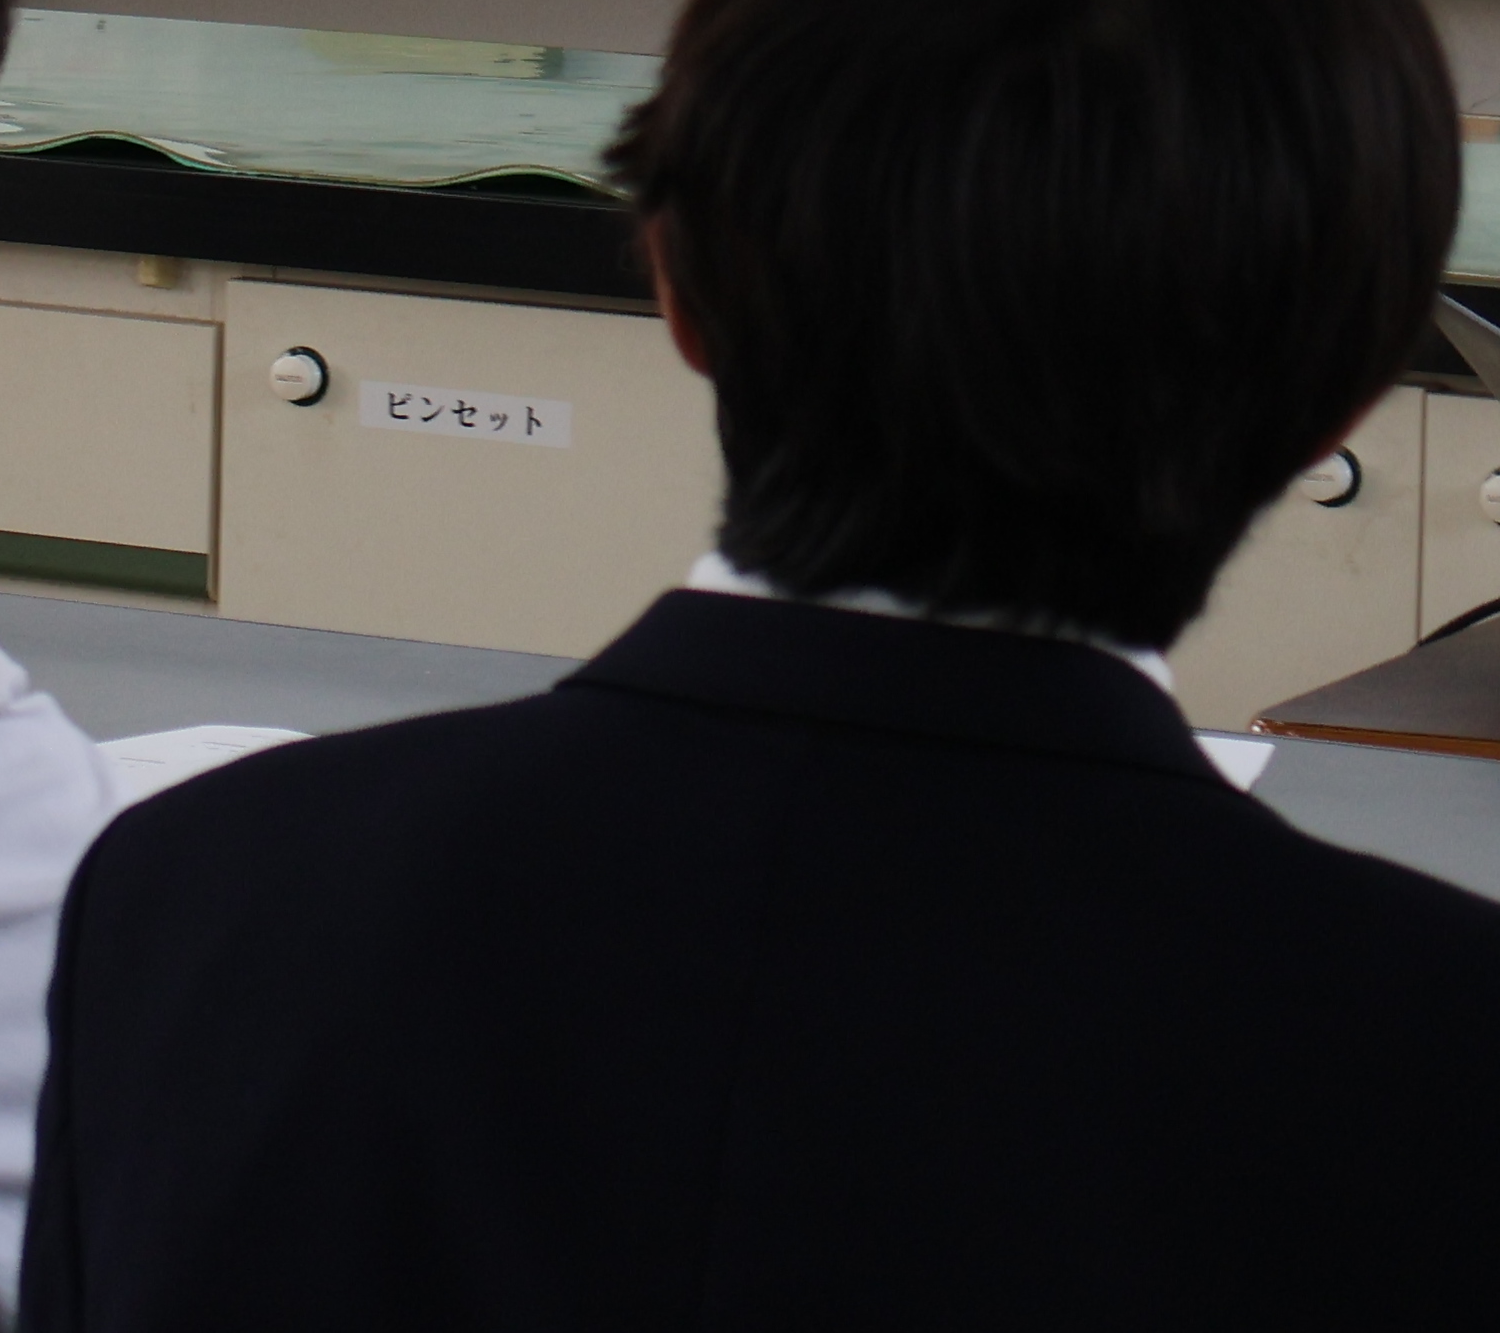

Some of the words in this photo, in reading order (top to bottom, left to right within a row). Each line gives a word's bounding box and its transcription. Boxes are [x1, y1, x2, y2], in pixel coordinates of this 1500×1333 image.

[388, 392, 543, 435] ピンセット
